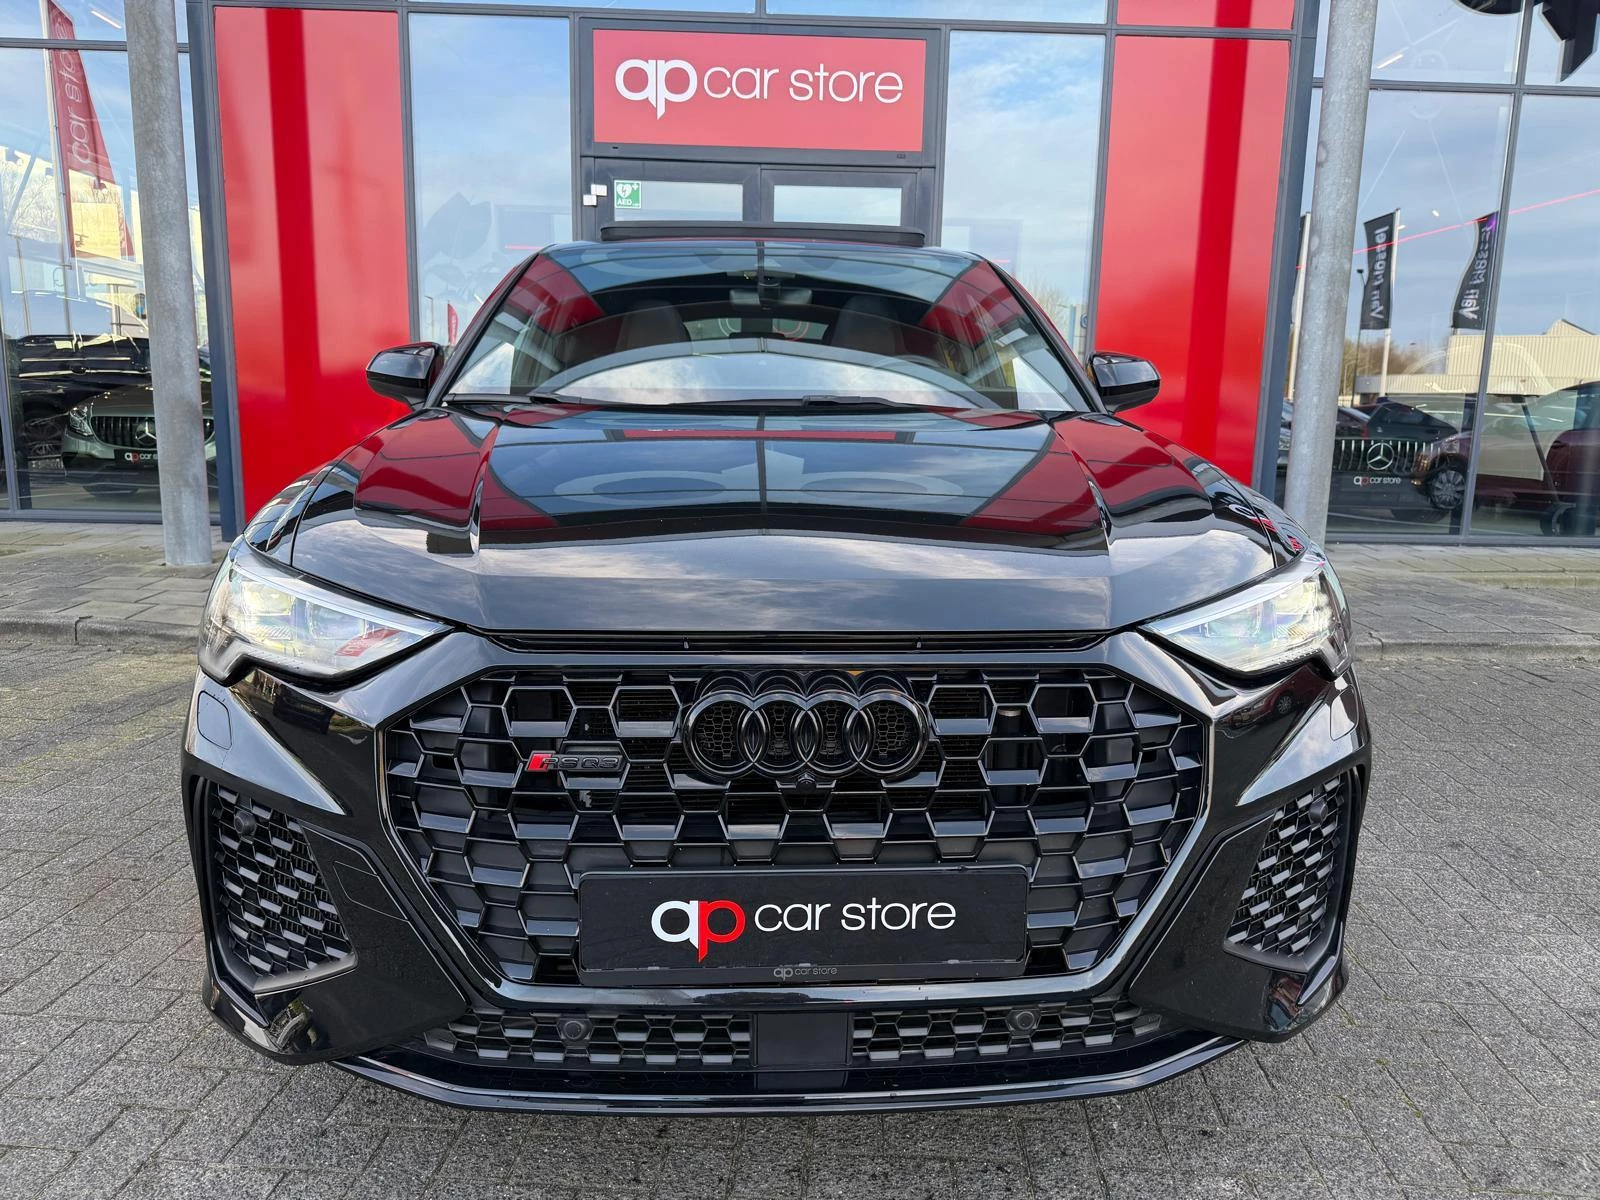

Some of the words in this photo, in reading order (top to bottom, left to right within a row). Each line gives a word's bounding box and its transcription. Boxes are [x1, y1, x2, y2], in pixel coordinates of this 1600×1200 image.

[55, 17, 83, 103] stoe
[703, 66, 779, 100] car
[789, 64, 904, 104] store
[617, 198, 633, 206] AED
[754, 903, 831, 932] car
[841, 897, 956, 931] store
[794, 968, 812, 976] car
[812, 967, 838, 975] store
